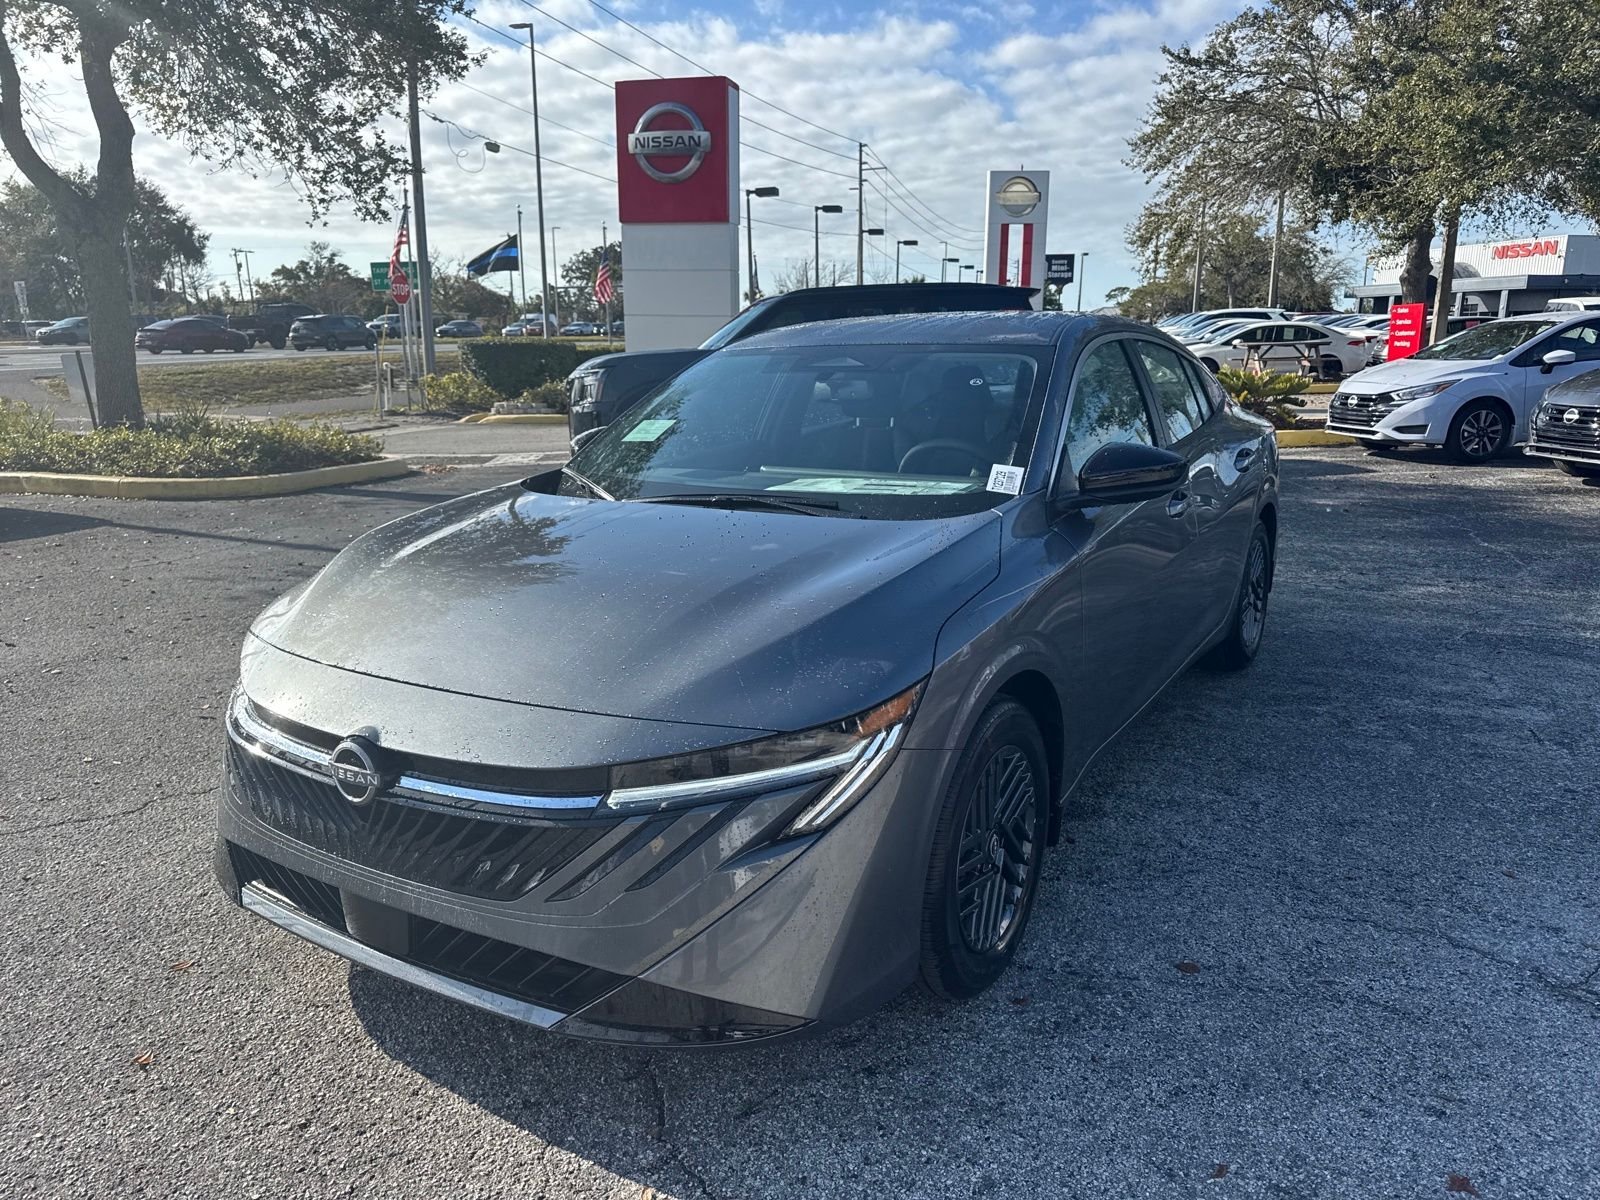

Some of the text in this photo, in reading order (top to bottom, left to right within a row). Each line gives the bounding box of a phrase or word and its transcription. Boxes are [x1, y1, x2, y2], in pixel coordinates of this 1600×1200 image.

[635, 135, 701, 149] NISSAN
[1492, 240, 1559, 260] NISSAN
[392, 284, 409, 295] STOP
[331, 766, 378, 785] NISSAN
